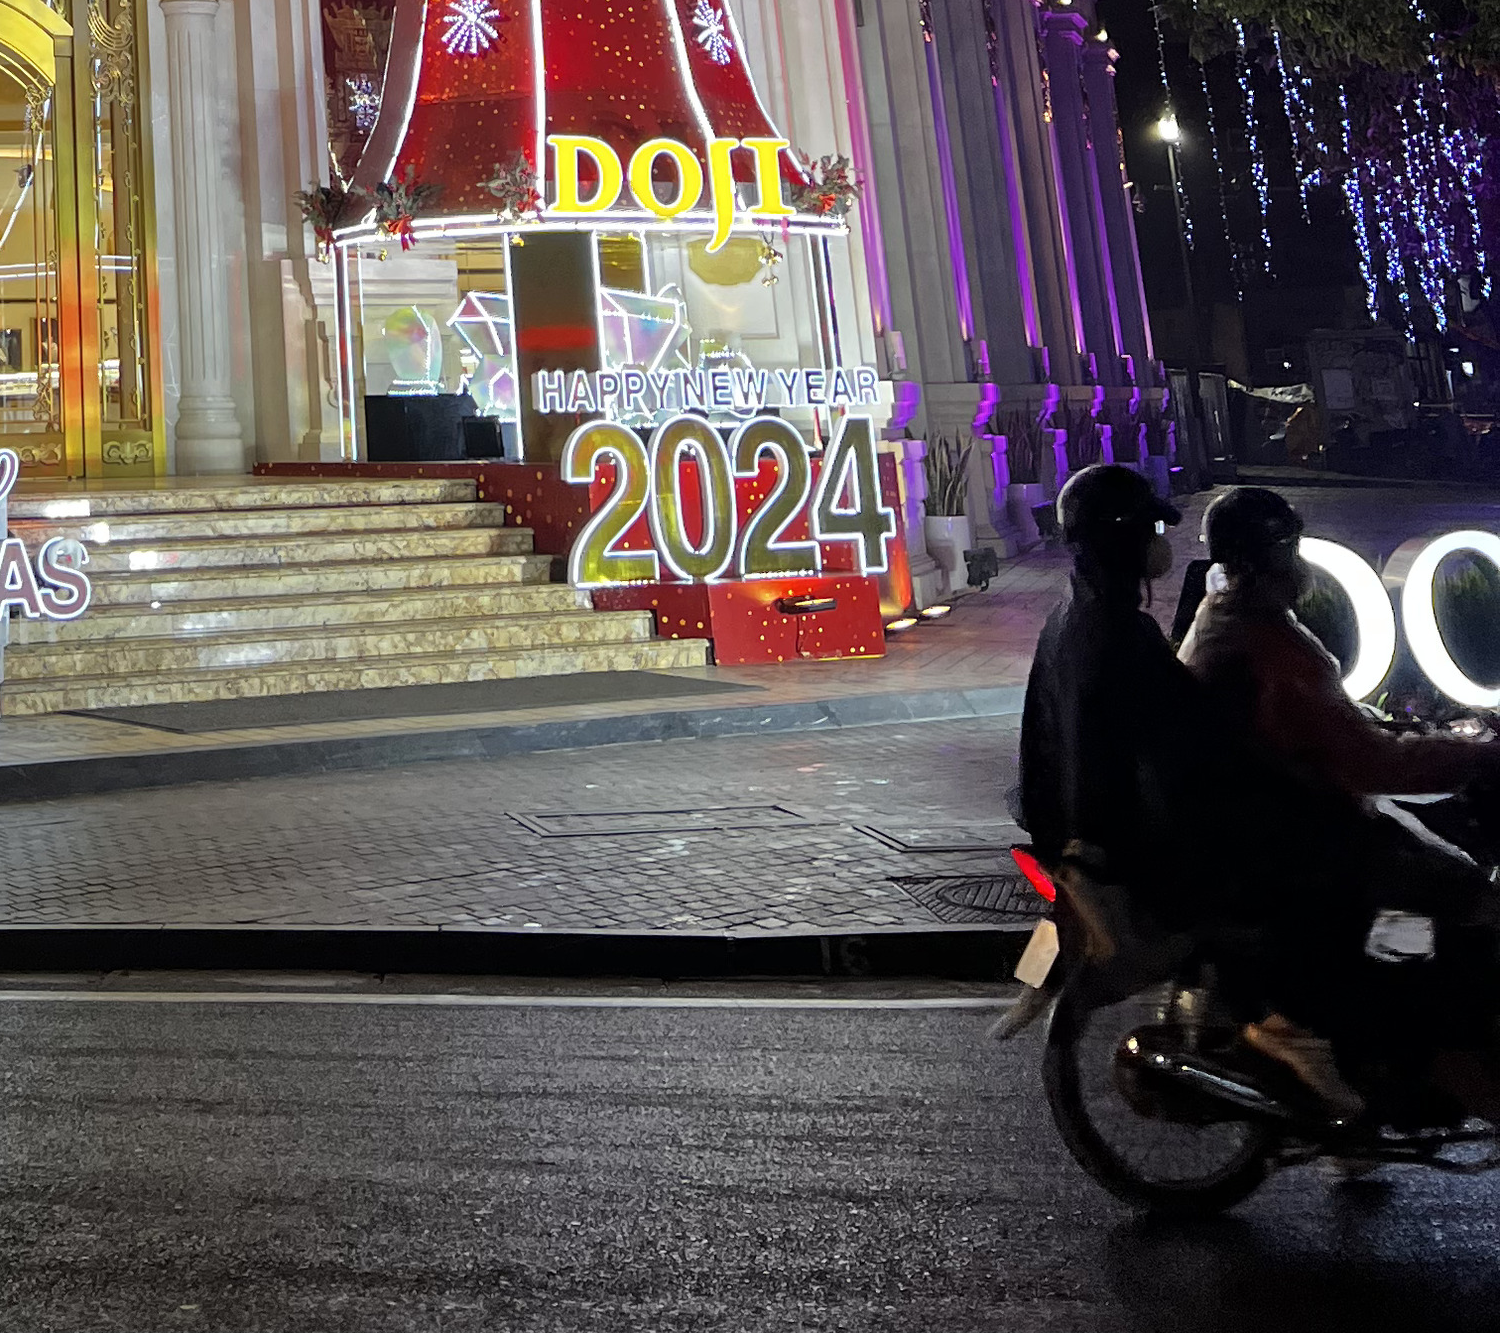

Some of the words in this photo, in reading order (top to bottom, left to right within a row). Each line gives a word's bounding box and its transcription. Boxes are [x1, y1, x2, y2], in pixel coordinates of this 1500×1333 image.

[545, 135, 799, 254] DOJI
[535, 370, 672, 414] HAPPY
[682, 368, 767, 409] NEW
[779, 365, 881, 407] YEAR
[560, 415, 897, 589] 2024
